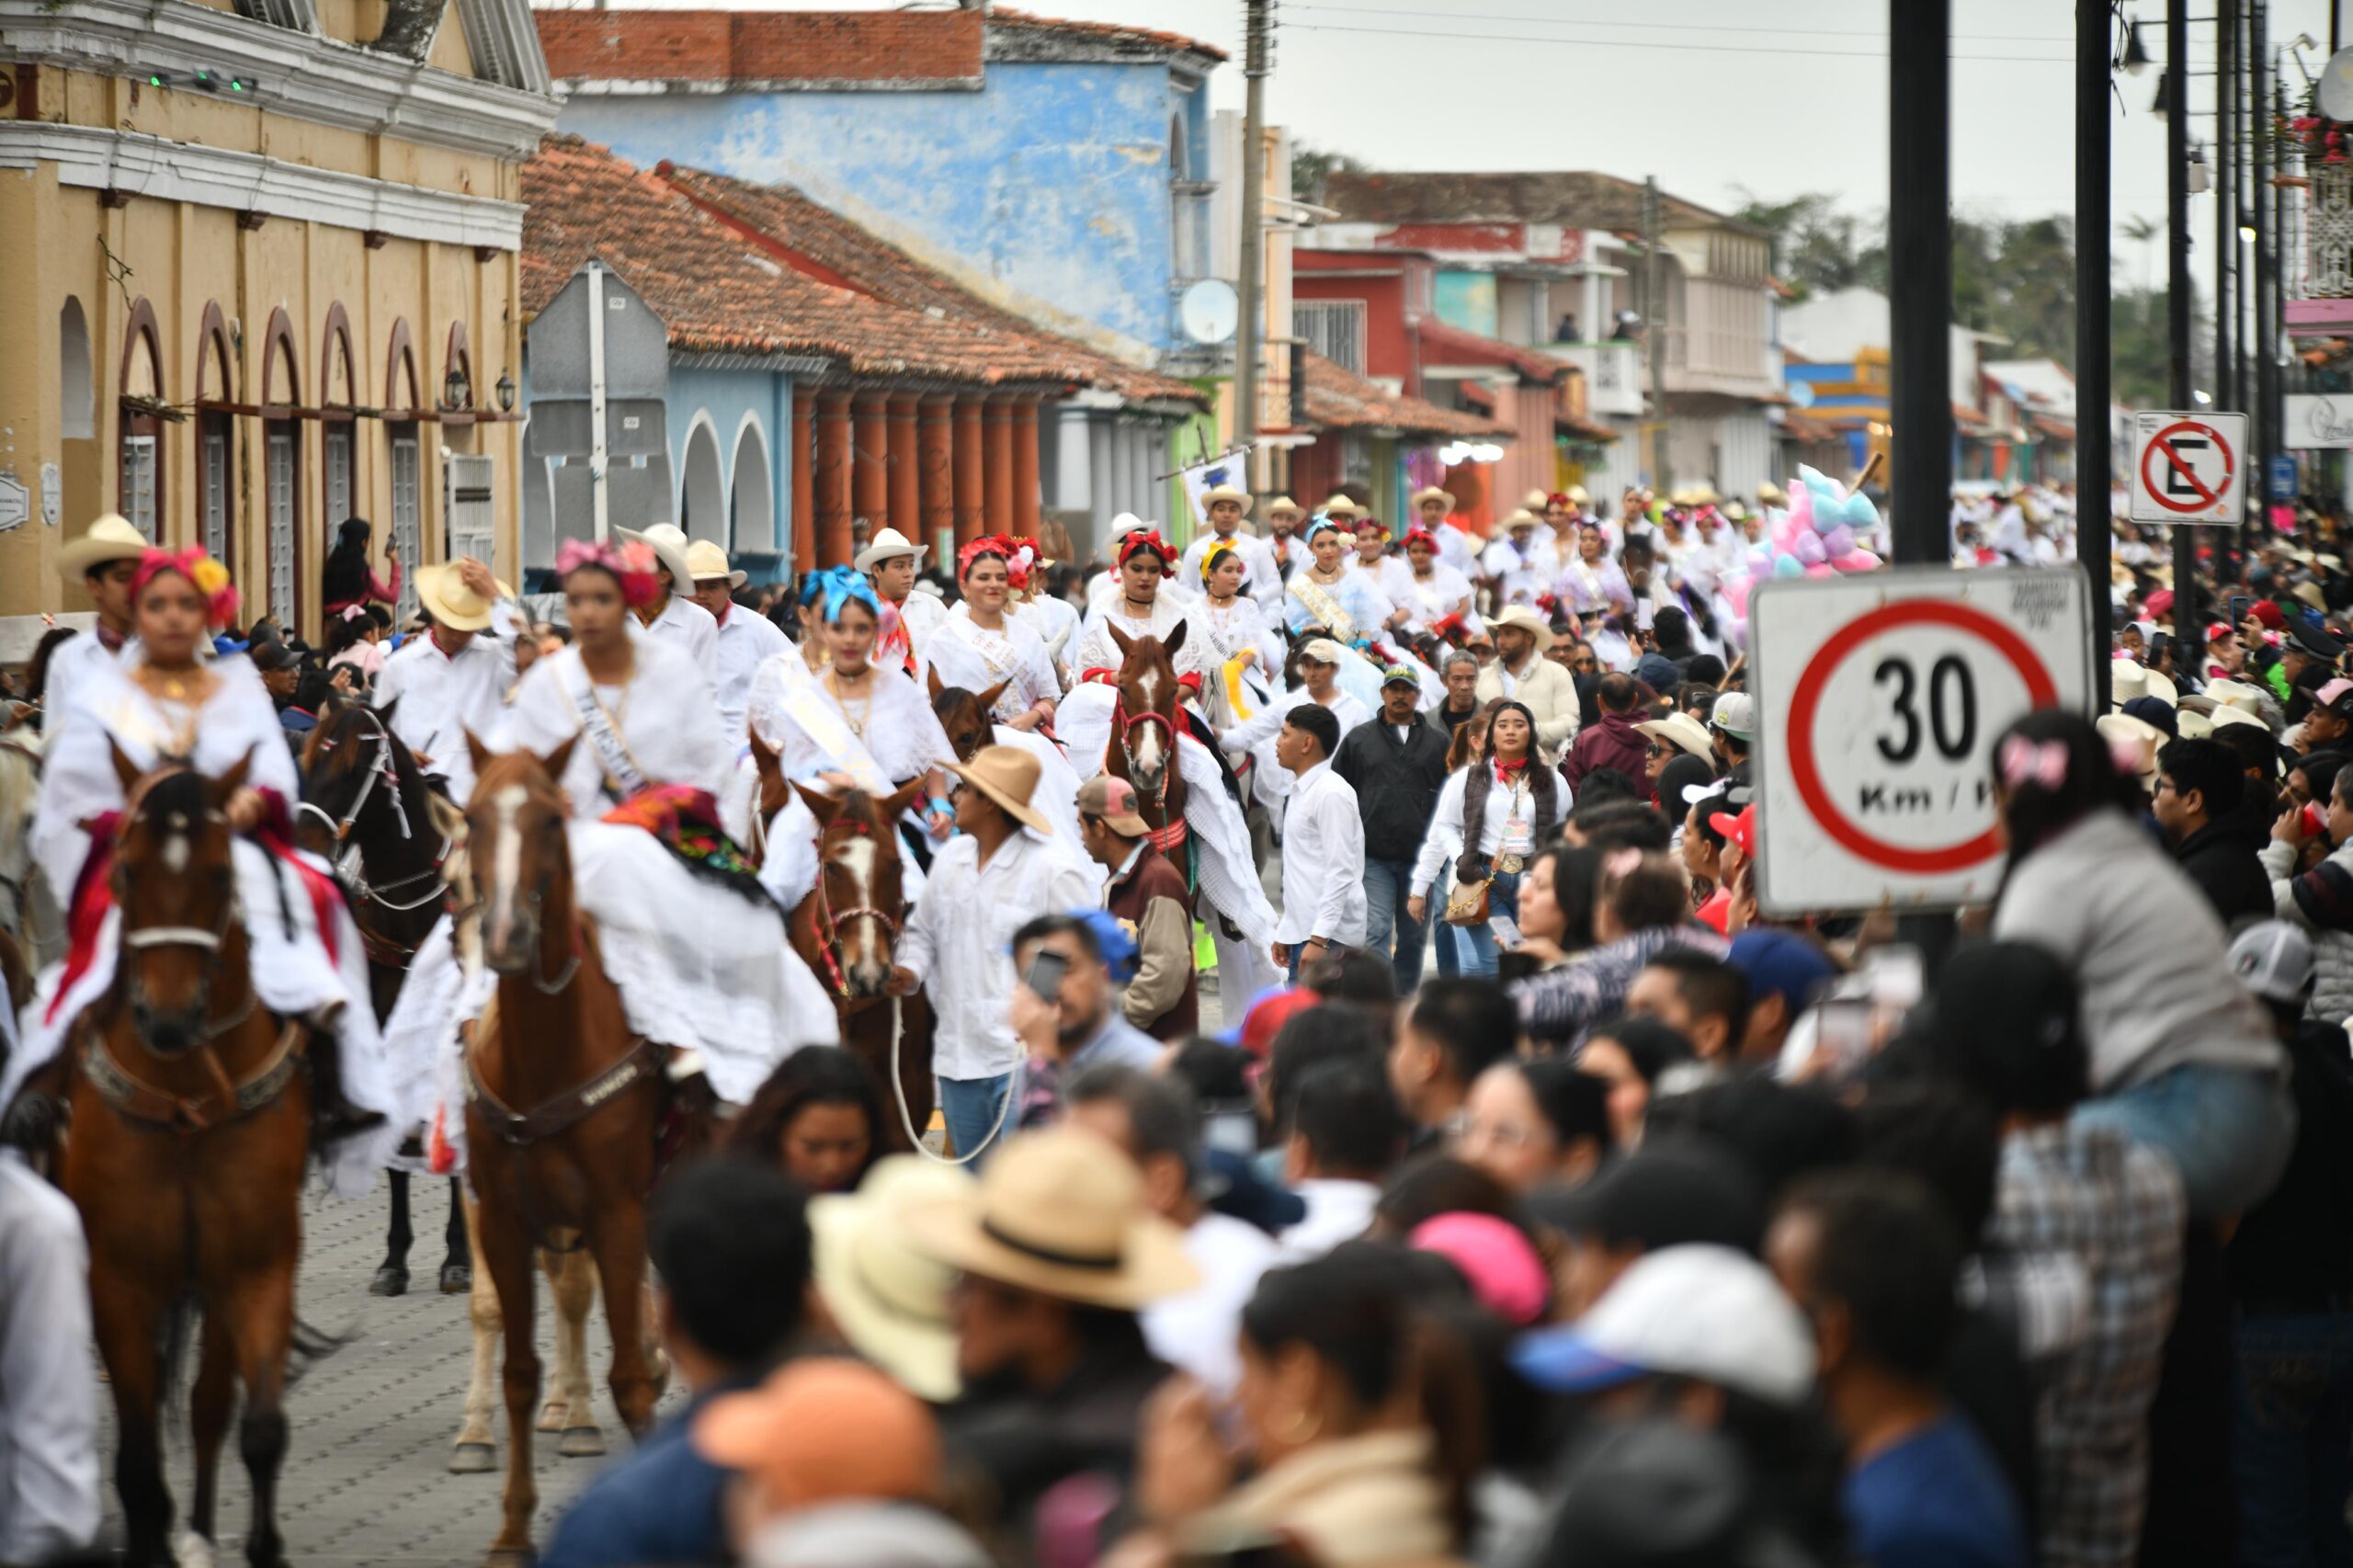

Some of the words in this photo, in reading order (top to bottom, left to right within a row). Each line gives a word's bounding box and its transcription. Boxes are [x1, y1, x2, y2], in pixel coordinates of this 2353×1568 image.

[2167, 439, 2209, 494] E
[1874, 653, 1977, 765] 30
[1859, 781, 1932, 812] Km
